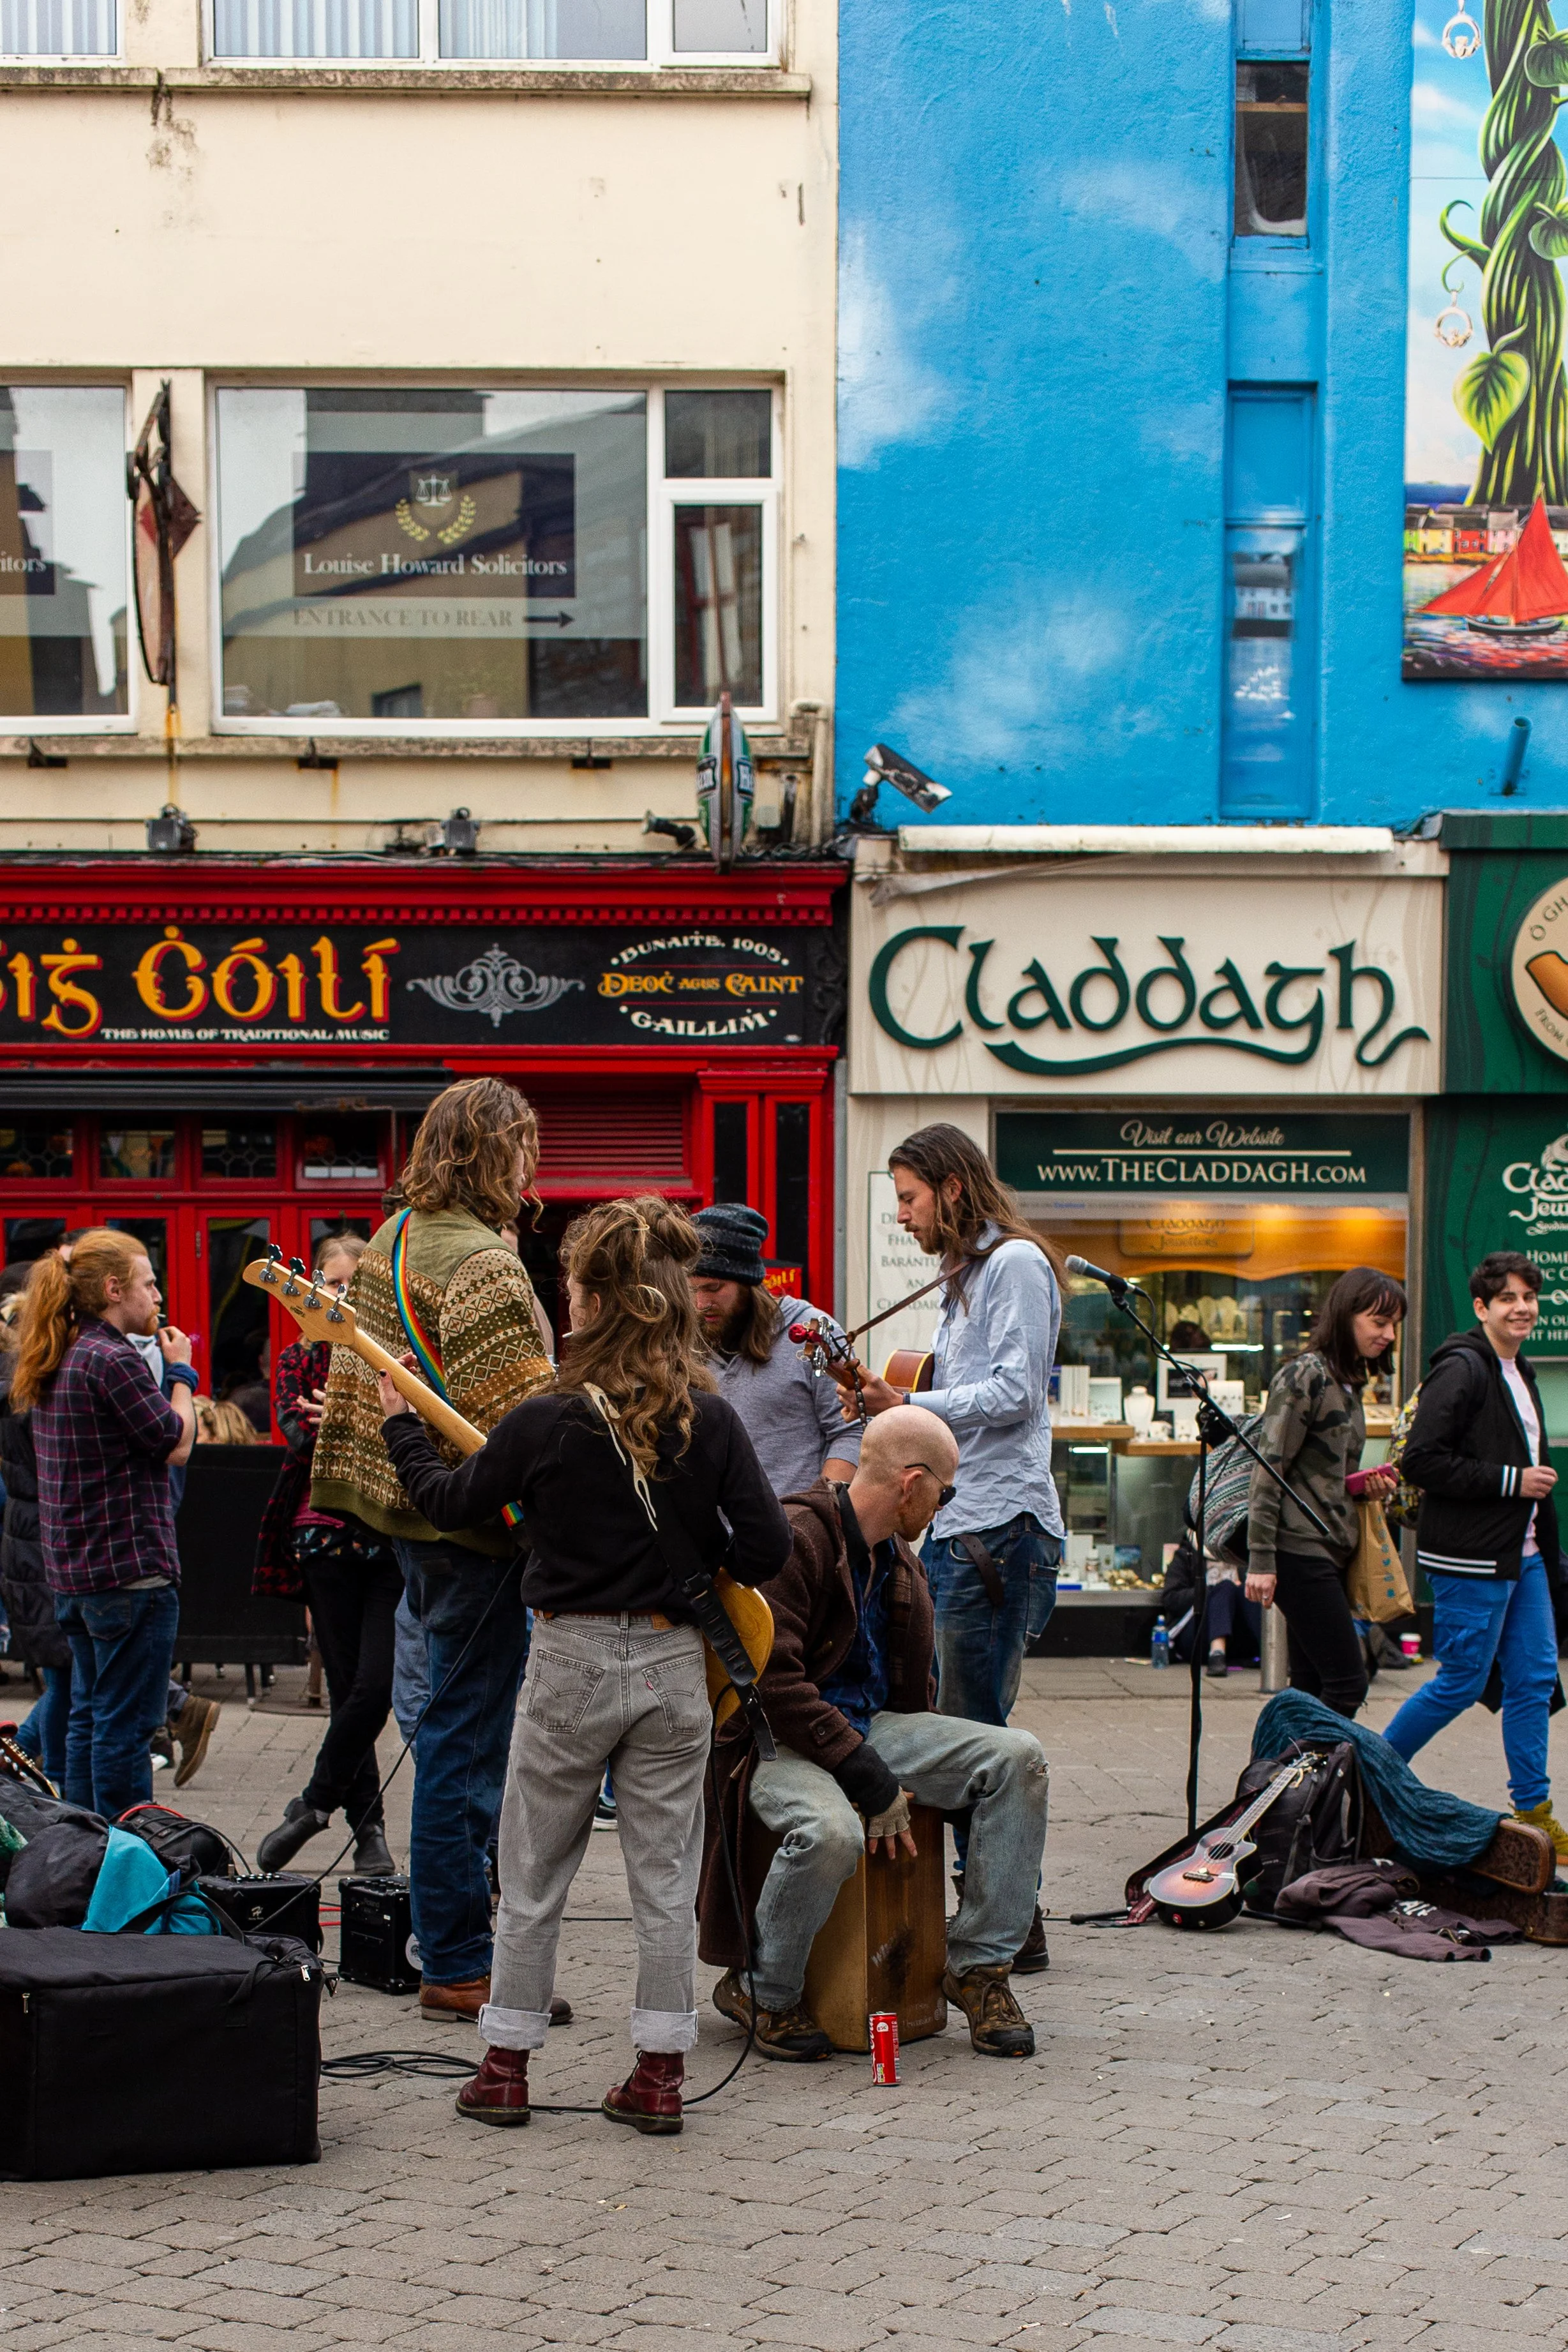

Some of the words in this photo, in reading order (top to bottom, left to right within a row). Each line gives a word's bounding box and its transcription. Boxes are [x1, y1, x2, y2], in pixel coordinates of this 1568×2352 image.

[304, 553, 374, 574] Louise
[381, 553, 465, 575] Howard
[470, 553, 567, 575] Solicitors
[293, 608, 413, 627] ENTRANCE
[419, 608, 451, 627] TO
[457, 608, 512, 627] REAR
[732, 937, 782, 963] 1905
[867, 925, 1431, 1077] Claddagh
[101, 1028, 138, 1040] THE
[140, 1028, 193, 1040] HOME
[196, 1028, 220, 1040] OF
[220, 1028, 334, 1042] TRADITIONAL
[336, 1028, 390, 1041] MUSIC
[1534, 1008, 1564, 1042] FROM
[1120, 1119, 1174, 1148] Visit
[1174, 1130, 1204, 1146] our
[1205, 1120, 1286, 1149] Website
